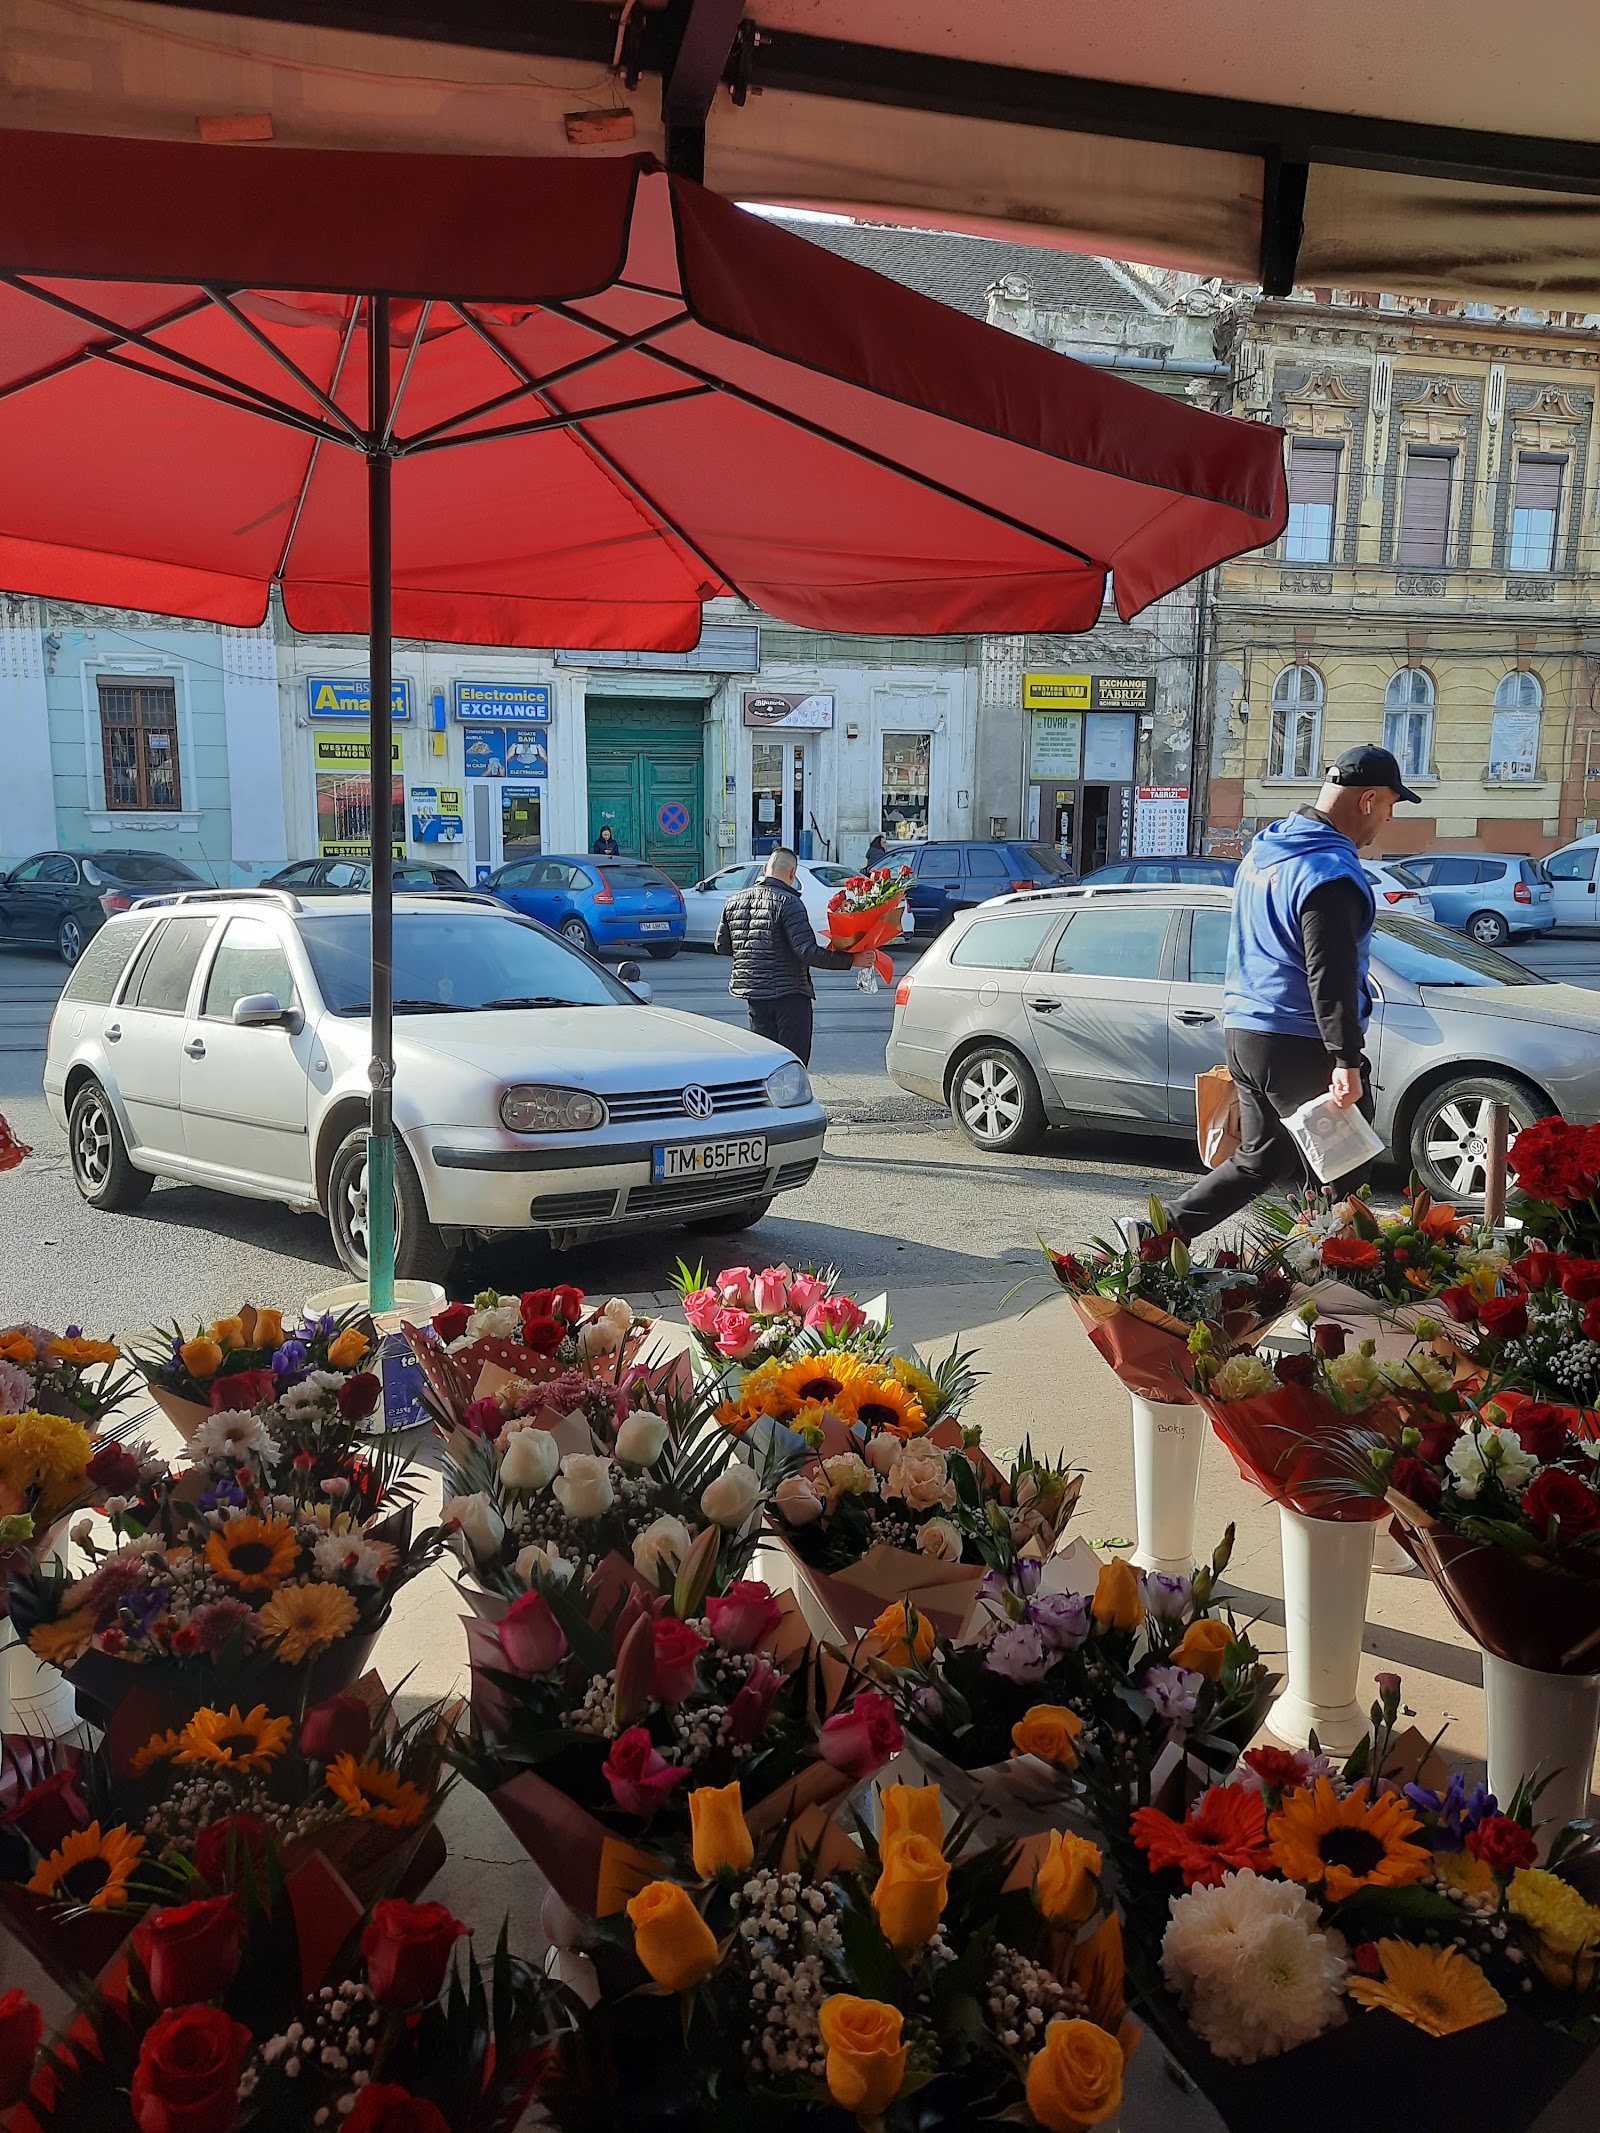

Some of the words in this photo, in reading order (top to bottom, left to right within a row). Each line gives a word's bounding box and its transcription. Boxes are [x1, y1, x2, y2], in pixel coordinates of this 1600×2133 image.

[355, 682, 370, 693] BS
[1099, 679, 1147, 688] EXCHANGE
[315, 685, 404, 712] Amat
[461, 687, 545, 702] Electronice
[1099, 688, 1147, 700] TABRIZI
[461, 703, 546, 717] EXCHANGE
[1042, 716, 1068, 729] TOVAR
[1120, 790, 1130, 857] EXCHANG
[655, 1165, 664, 1175] RO
[667, 1148, 696, 1174] TM
[703, 1140, 763, 1169] 65FRC
